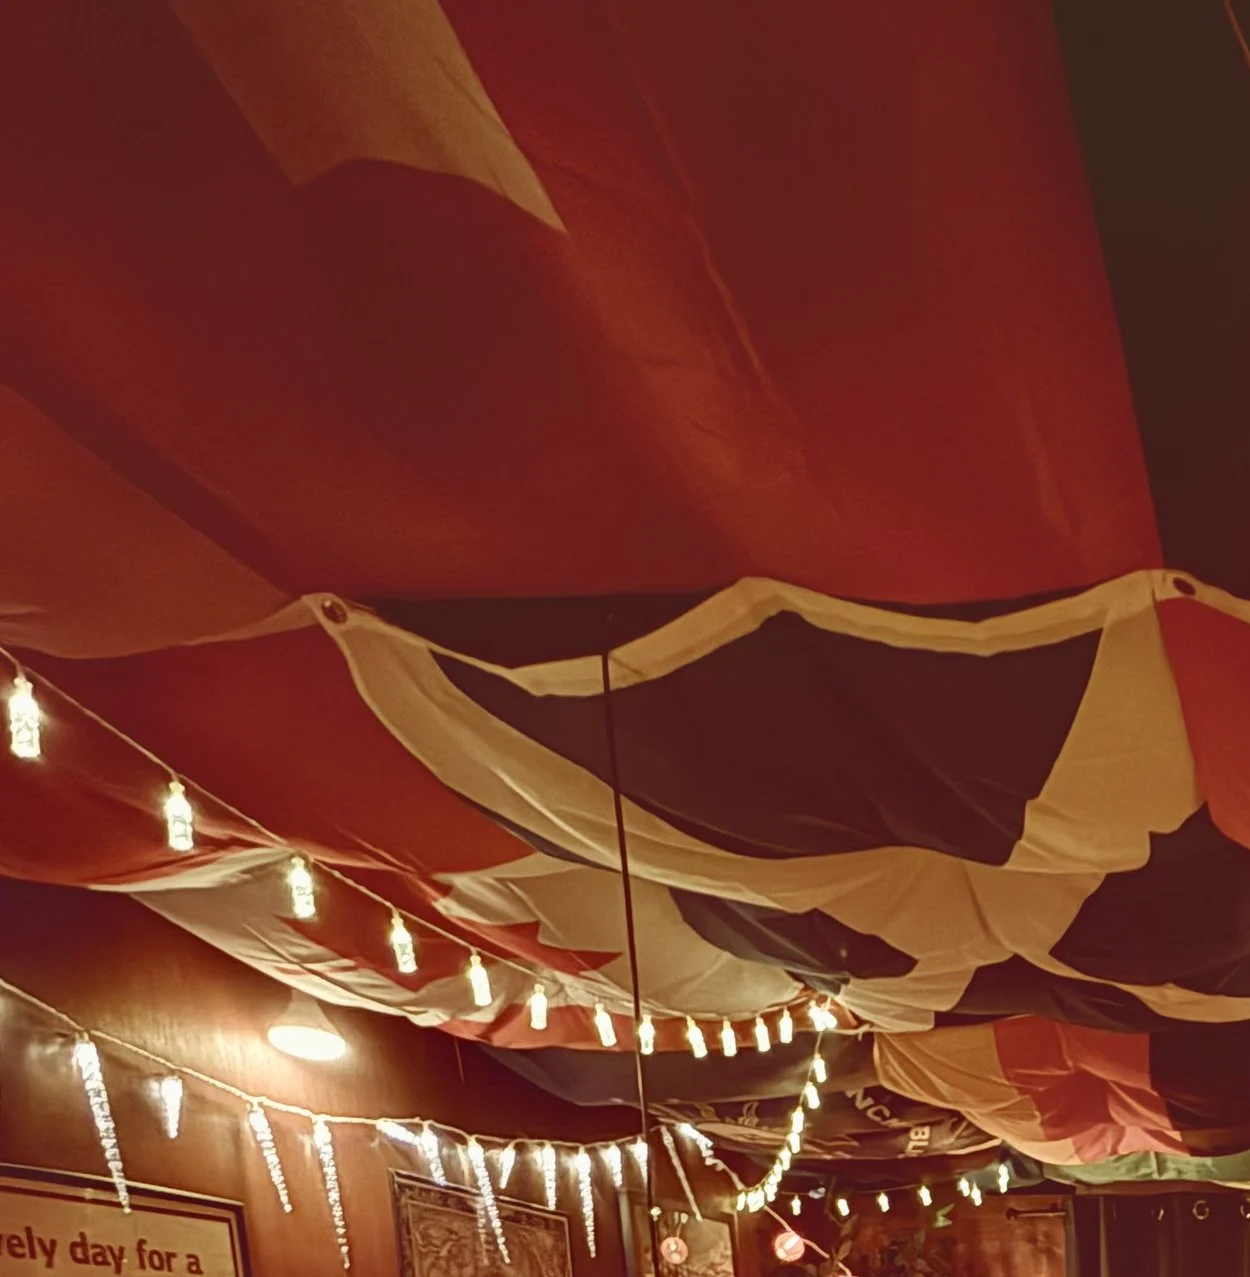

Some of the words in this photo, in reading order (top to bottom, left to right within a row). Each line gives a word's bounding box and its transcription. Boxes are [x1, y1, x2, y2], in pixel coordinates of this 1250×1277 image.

[0, 1226, 57, 1269] ely
[68, 1231, 125, 1275] day
[136, 1238, 178, 1273] for
[185, 1253, 204, 1276] a
